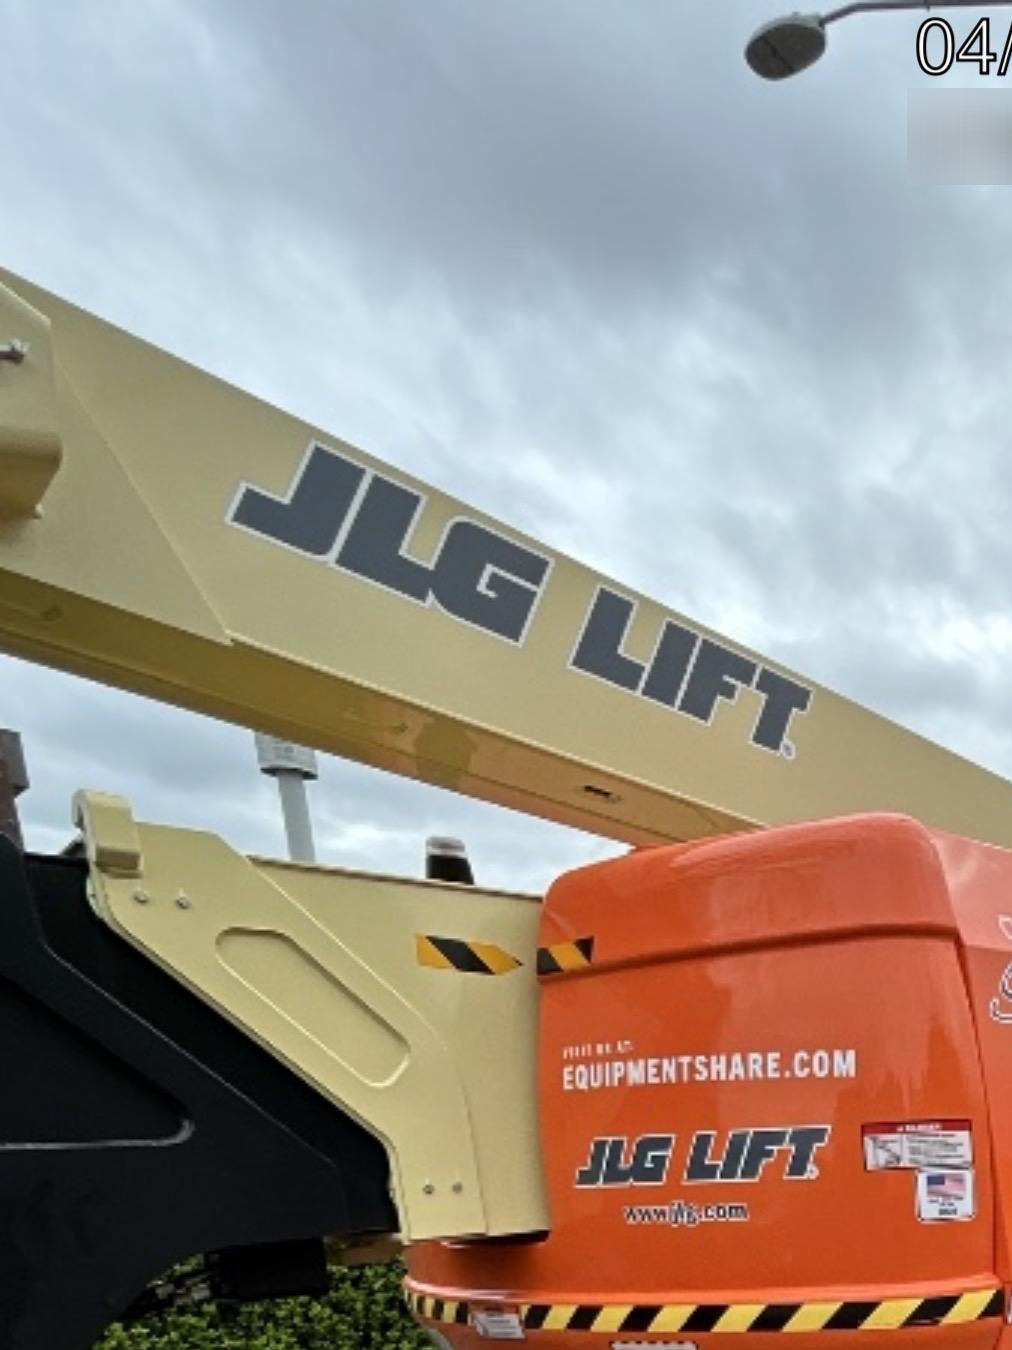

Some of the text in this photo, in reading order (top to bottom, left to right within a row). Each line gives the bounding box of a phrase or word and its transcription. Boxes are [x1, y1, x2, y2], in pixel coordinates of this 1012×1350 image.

[226, 440, 814, 760] JLG LIFT
[563, 1050, 858, 1093] EQUIPMENTSHARE.COM
[575, 1124, 832, 1188] JLG LIFT
[624, 1201, 749, 1227] www.jlg.com
